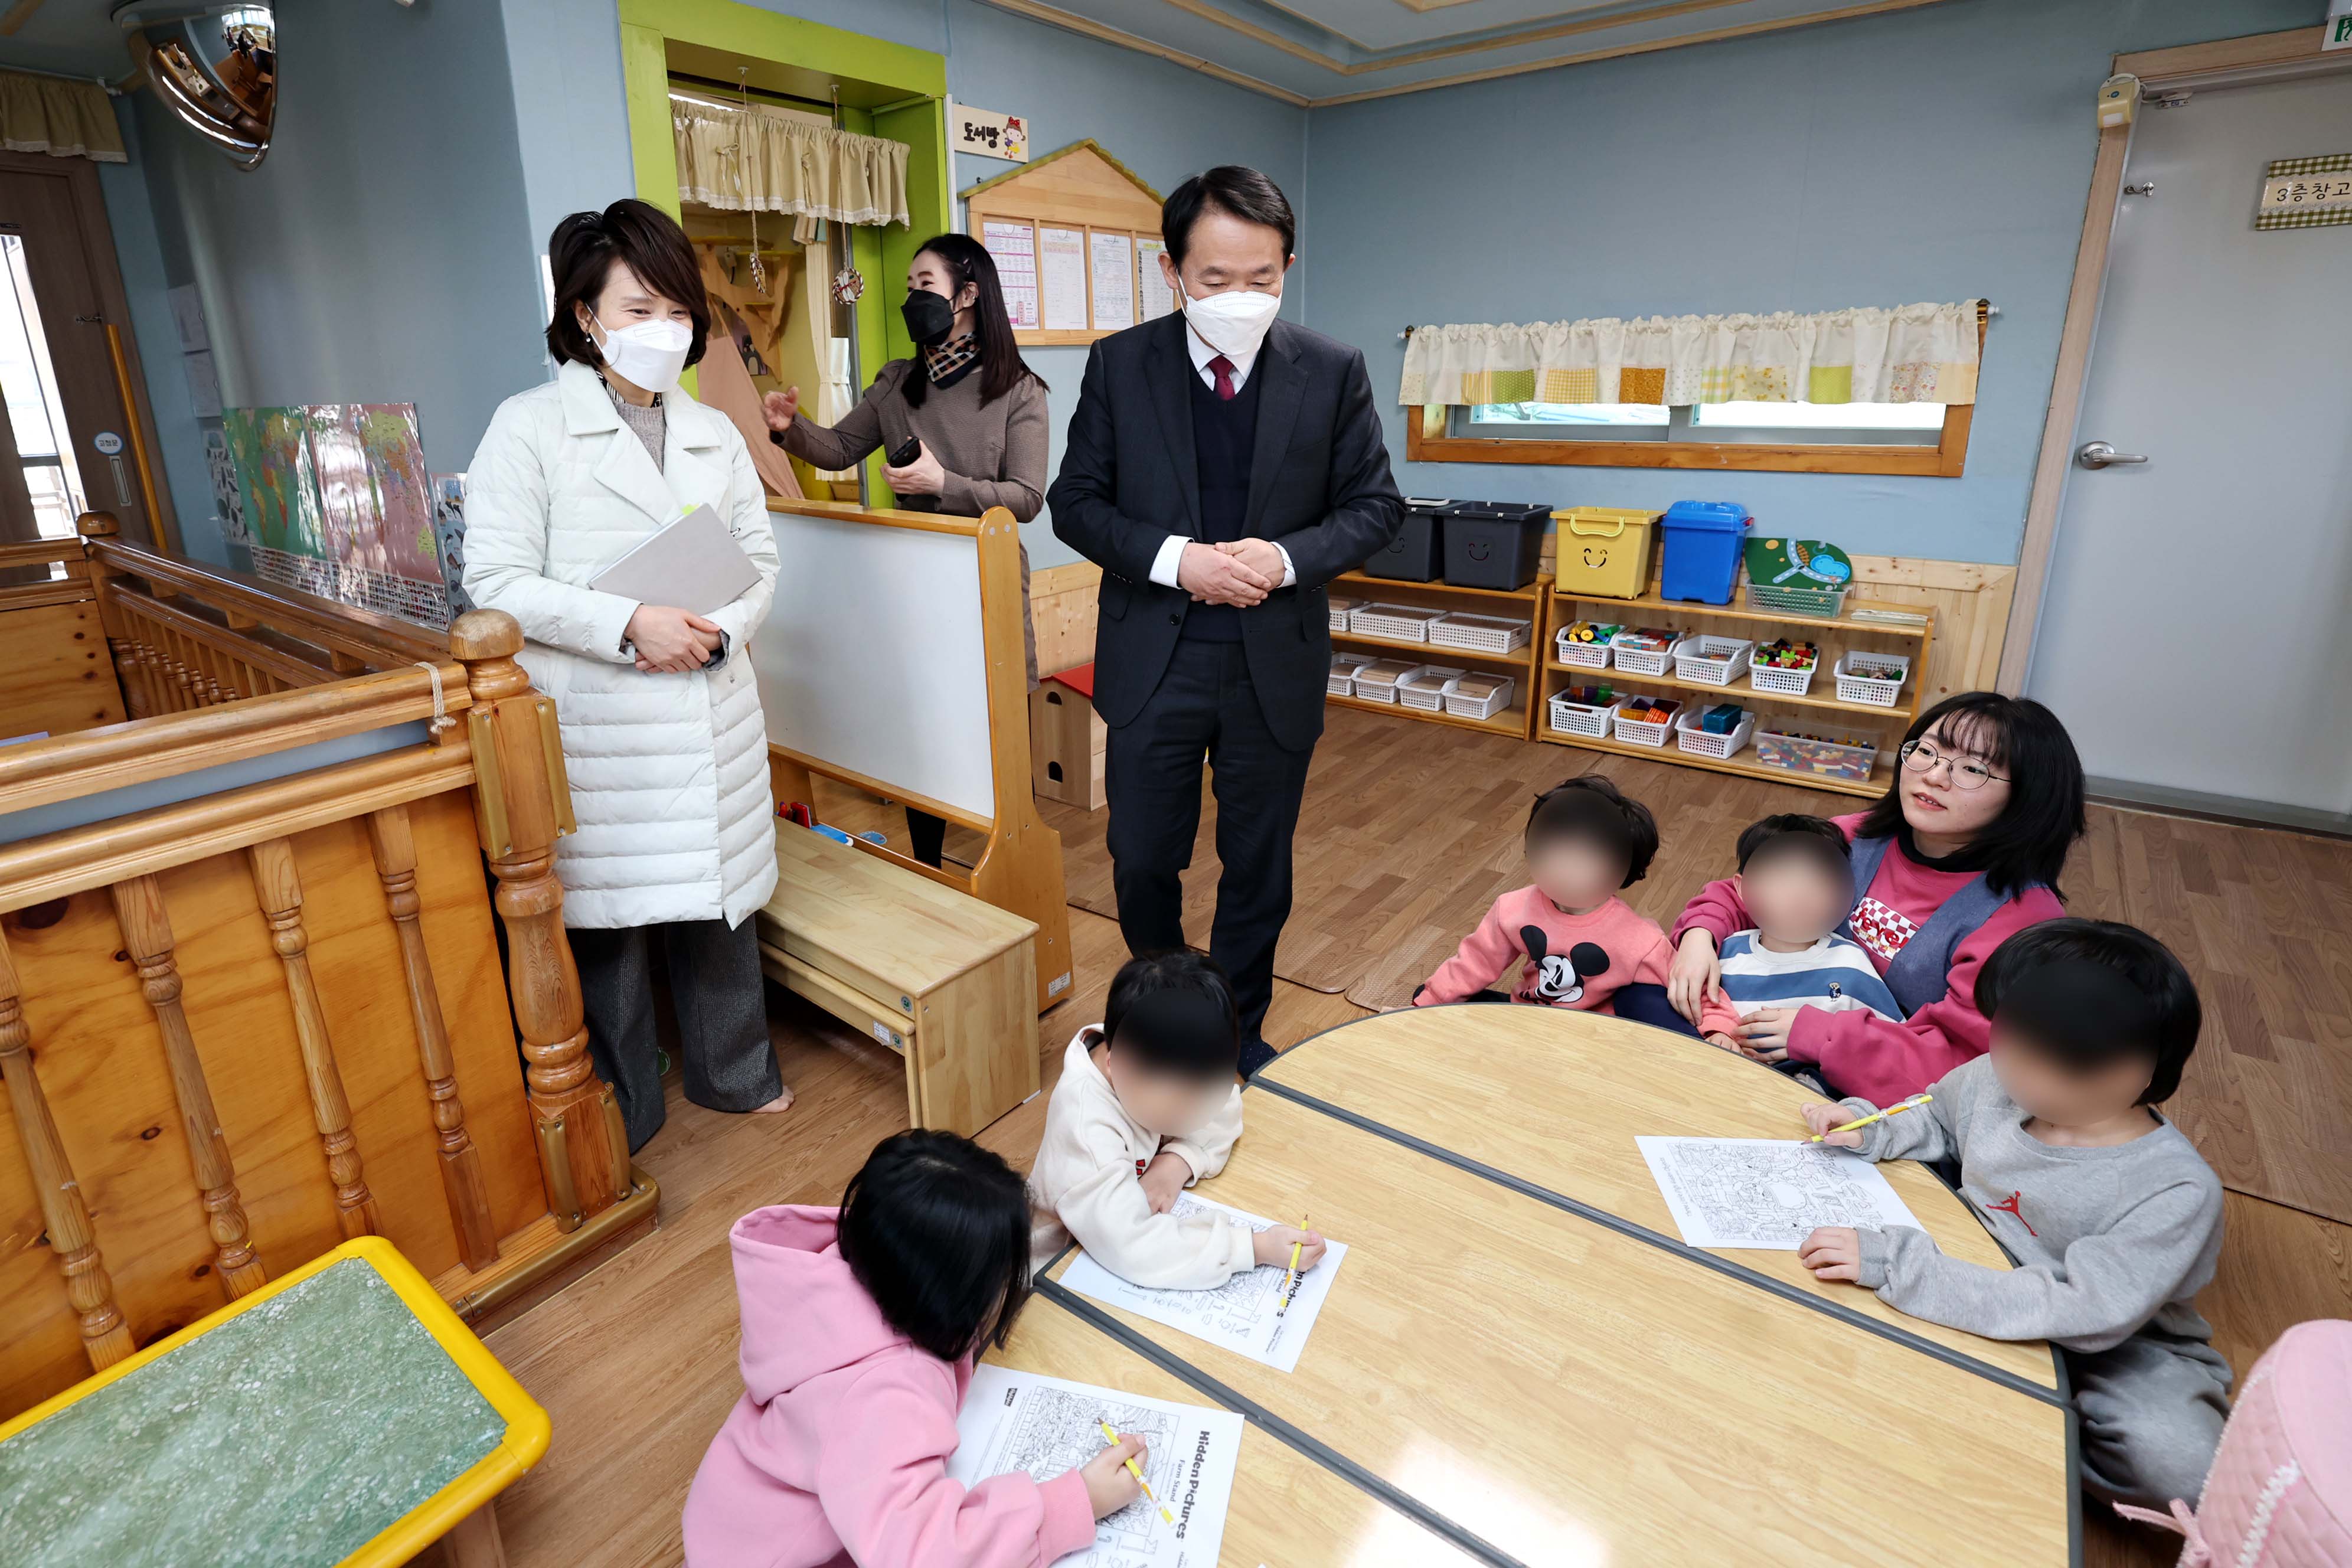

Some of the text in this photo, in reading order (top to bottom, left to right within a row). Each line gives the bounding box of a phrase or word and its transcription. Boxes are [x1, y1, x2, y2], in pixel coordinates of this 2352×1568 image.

[963, 122, 999, 149] 도서방
[2276, 182, 2351, 202] 3층창고
[1277, 1280, 1302, 1318] Pictus
[1175, 1459, 1185, 1478] Farm
[1170, 1480, 1181, 1502] Stand
[1176, 1430, 1210, 1539] Hidden Pictures
